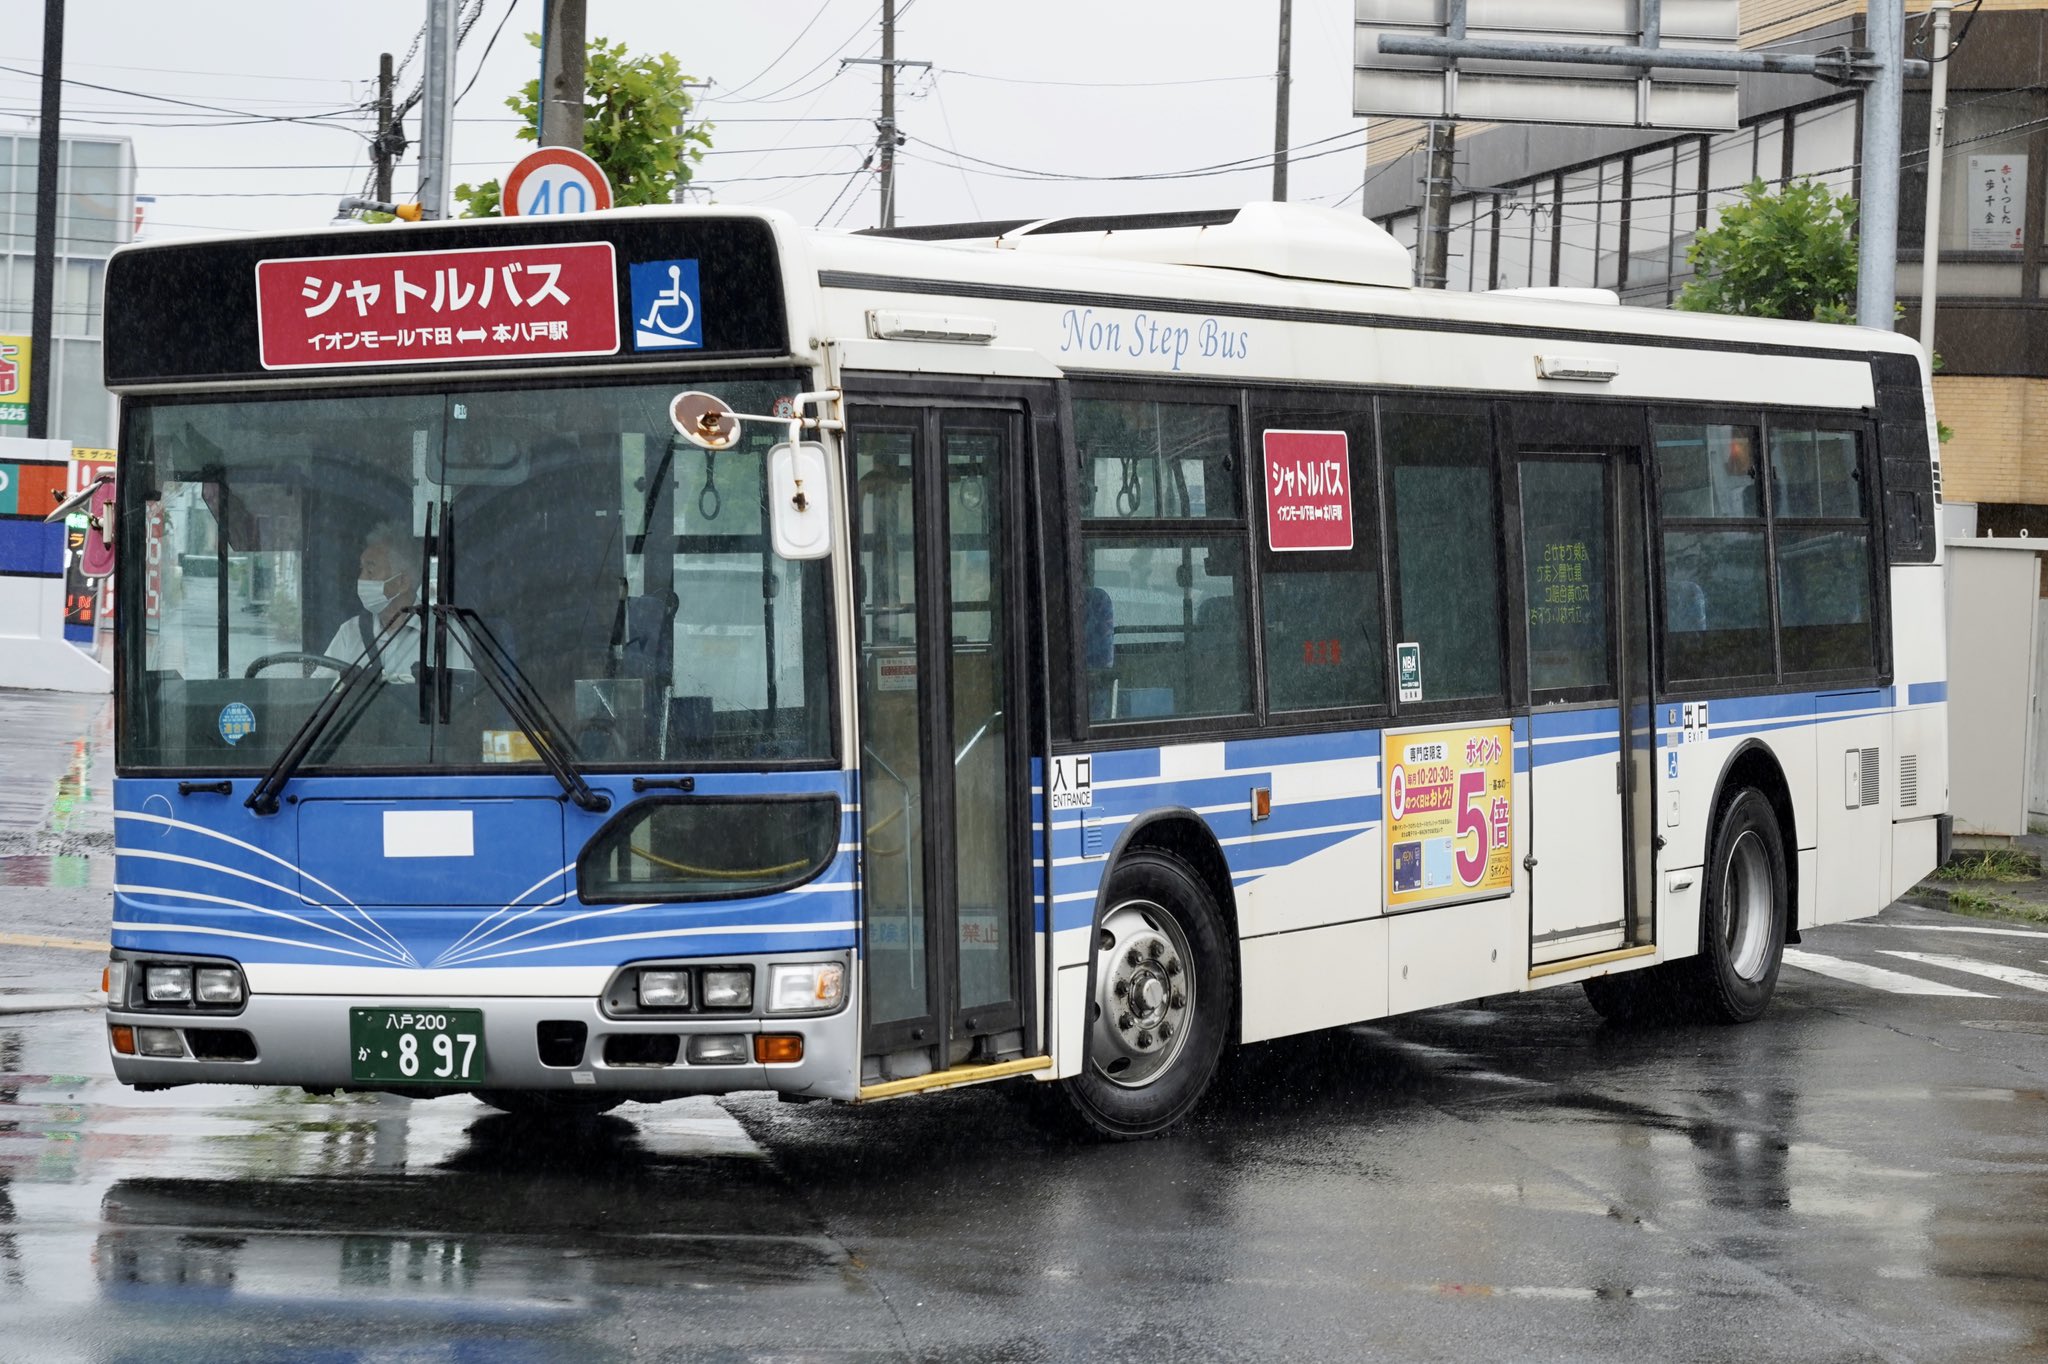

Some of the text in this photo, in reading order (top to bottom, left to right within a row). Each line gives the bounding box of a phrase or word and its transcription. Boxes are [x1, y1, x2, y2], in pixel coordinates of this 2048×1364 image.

[528, 180, 585, 215] 40
[301, 263, 570, 318] シャトルバス
[307, 321, 568, 351] イオンモール下田 本八戸駅
[1061, 309, 1248, 371] Non Step Bus
[1273, 460, 1344, 497] シャトルバス
[1402, 656, 1416, 669] NBA
[1684, 704, 1707, 730] 出口
[1466, 736, 1501, 765] ポイント
[1688, 730, 1704, 742] EXIT
[1410, 745, 1442, 762] 専門店限定
[1053, 757, 1090, 791] 入口
[1053, 791, 1091, 808] ENTRANCE
[1455, 769, 1489, 887] 5
[1489, 796, 1509, 848] 倍
[1491, 865, 1509, 877] 5ポイント
[386, 1014, 447, 1030] 八戸200
[358, 1046, 371, 1062] か
